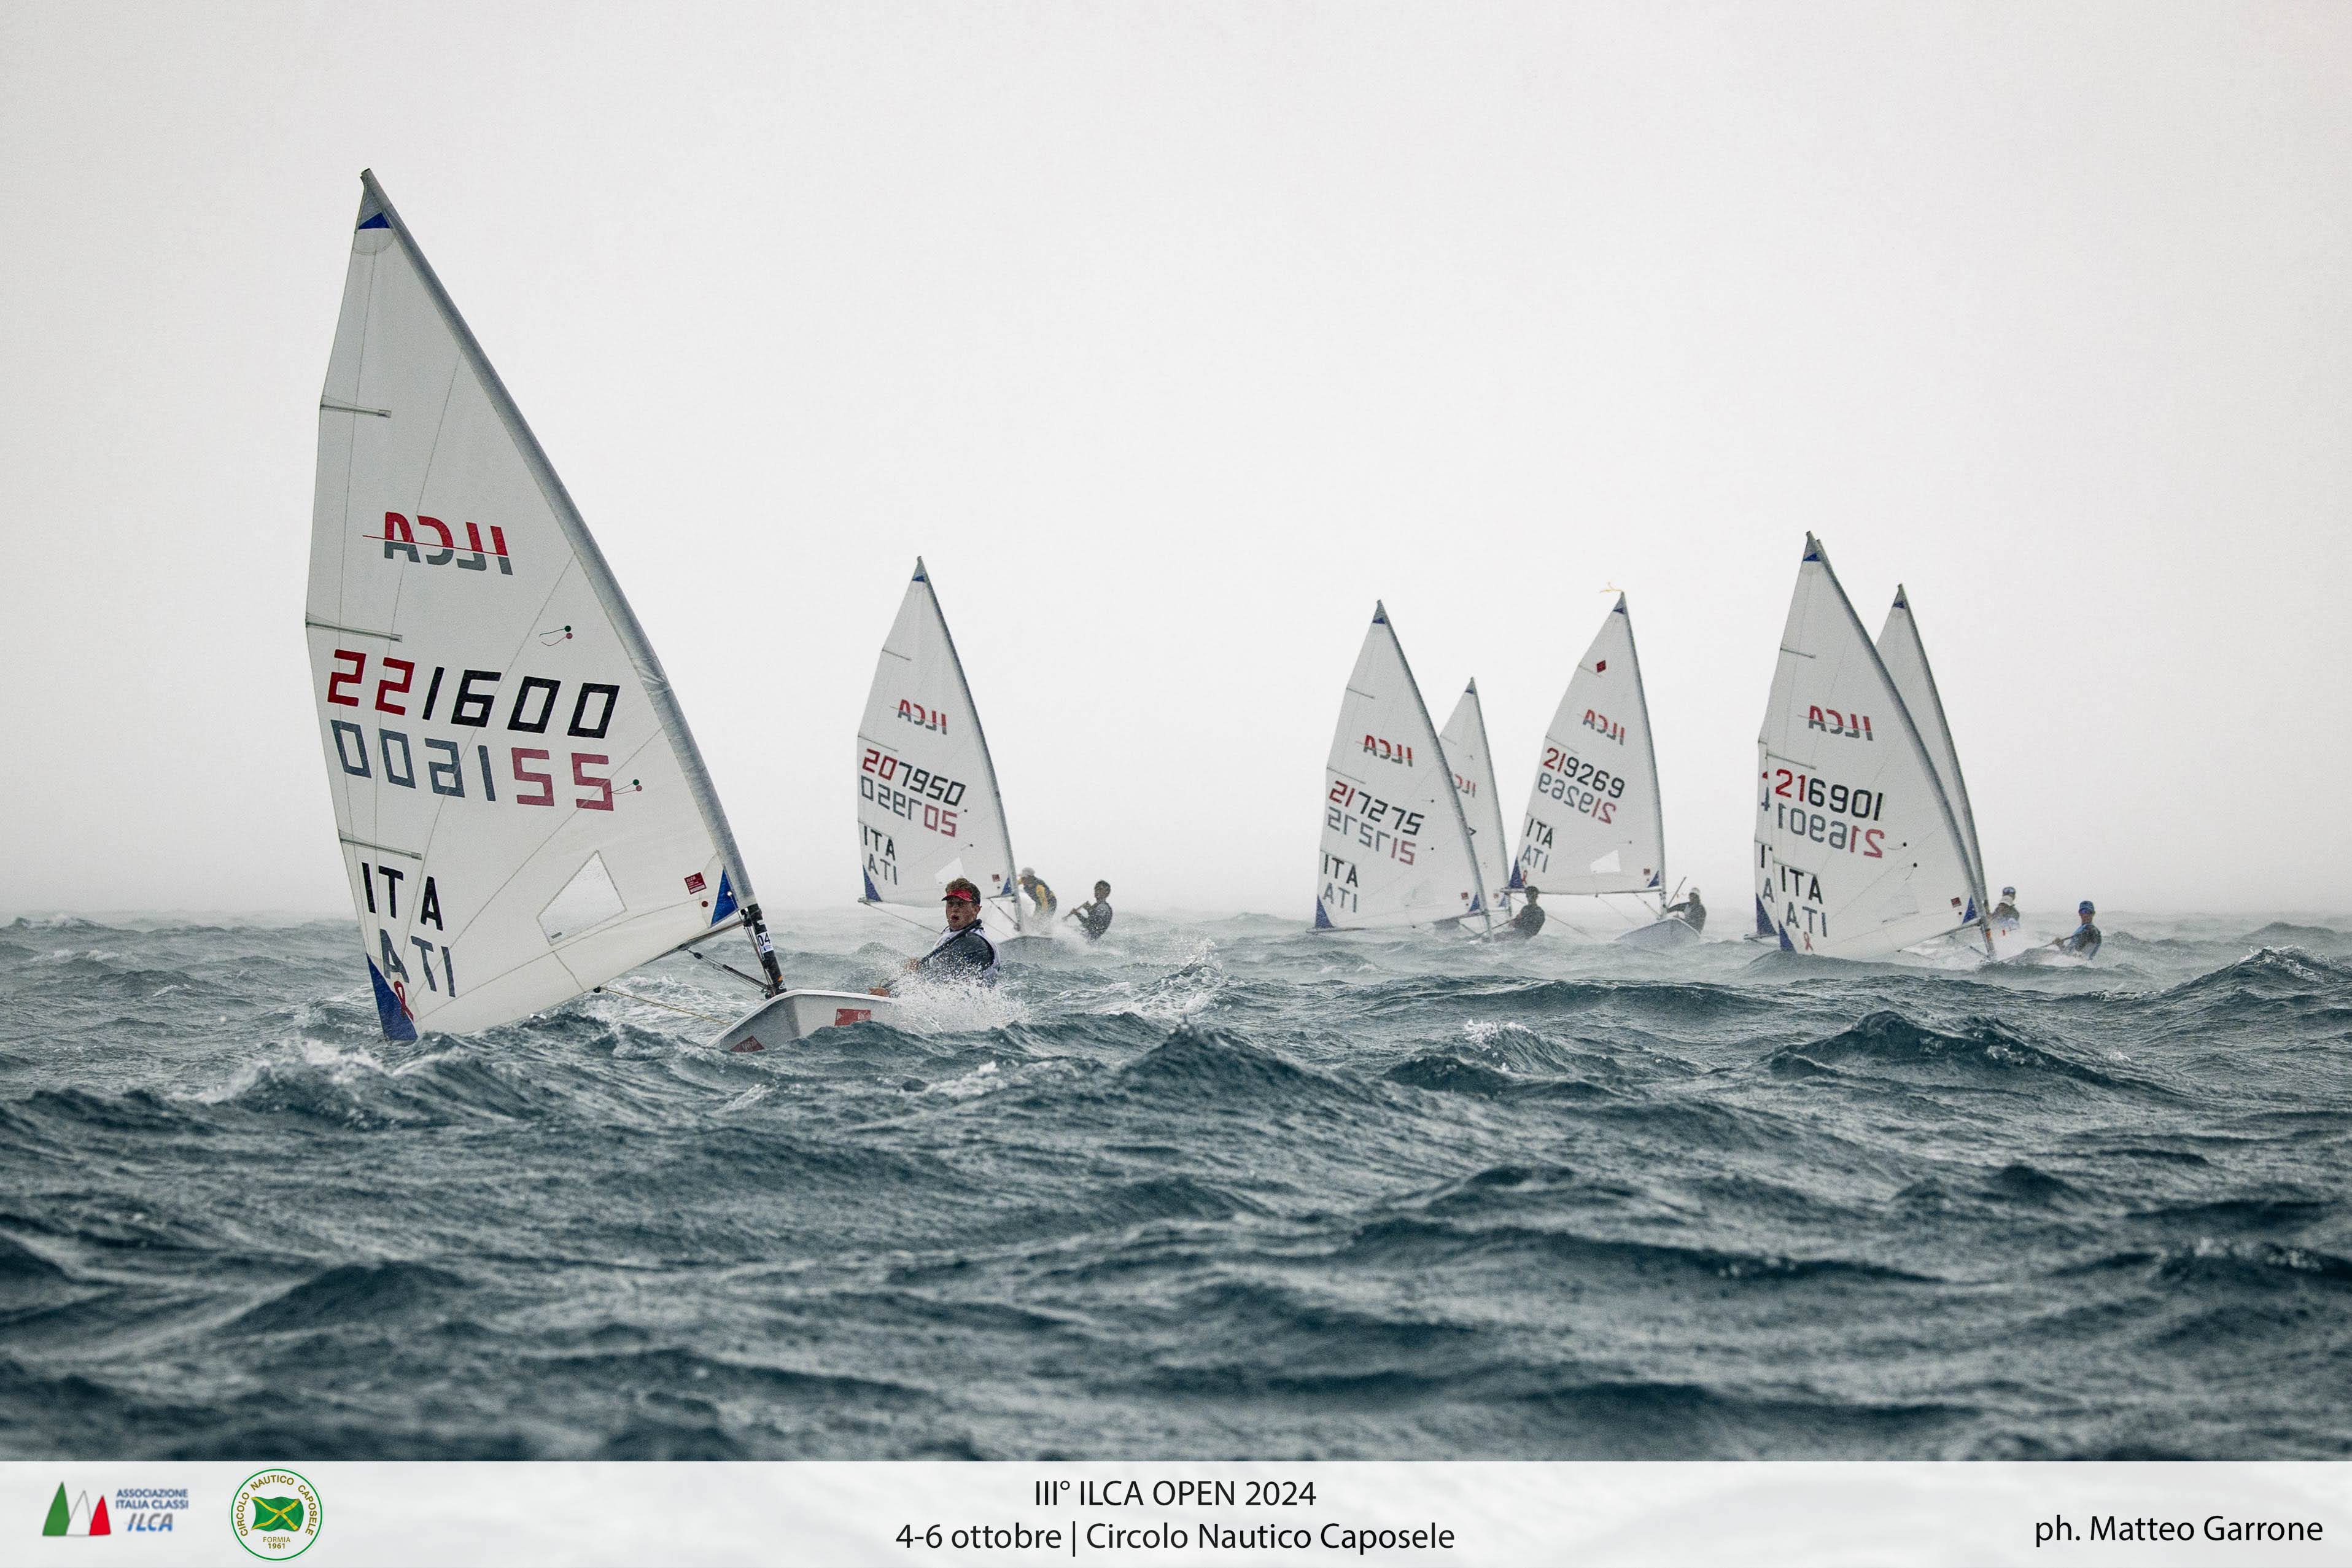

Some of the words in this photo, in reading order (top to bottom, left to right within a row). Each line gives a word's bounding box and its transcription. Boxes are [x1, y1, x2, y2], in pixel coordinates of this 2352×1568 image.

[327, 649, 619, 739] 221600
[862, 748, 966, 807] 207950
[1543, 747, 1625, 799] 219269
[1775, 769, 1884, 821] 216901
[1329, 780, 1424, 836] 217275
[1526, 818, 1554, 849] ITA
[863, 826, 896, 861] ITA
[362, 862, 443, 931] ITA
[1324, 854, 1359, 888] ITA
[1781, 866, 1823, 905] ITA
